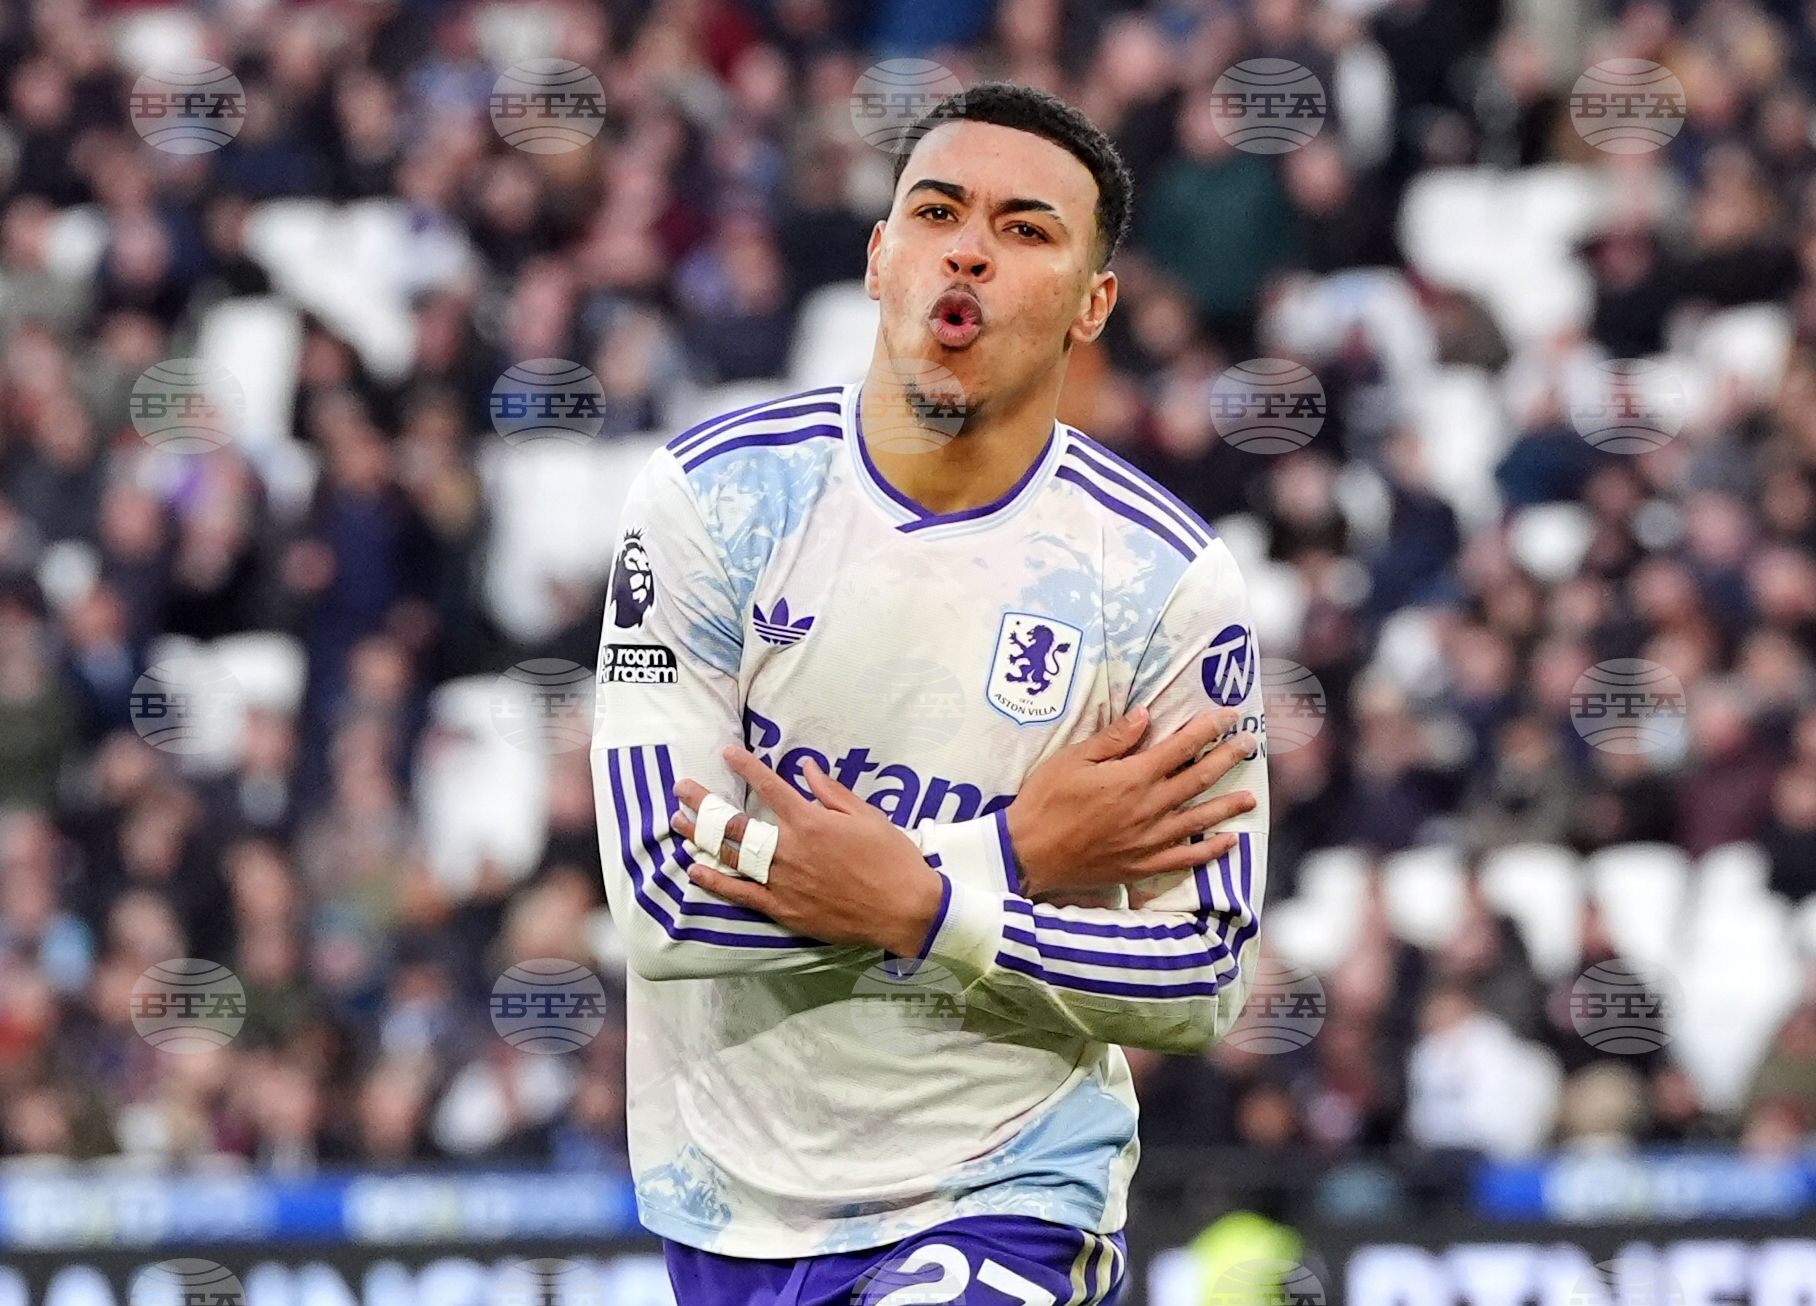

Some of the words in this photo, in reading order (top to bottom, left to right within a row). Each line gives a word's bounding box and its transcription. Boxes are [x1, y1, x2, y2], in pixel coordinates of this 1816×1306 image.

[616, 648, 667, 667] room
[994, 693, 1025, 715] ASTON
[1027, 705, 1057, 716] VILLA
